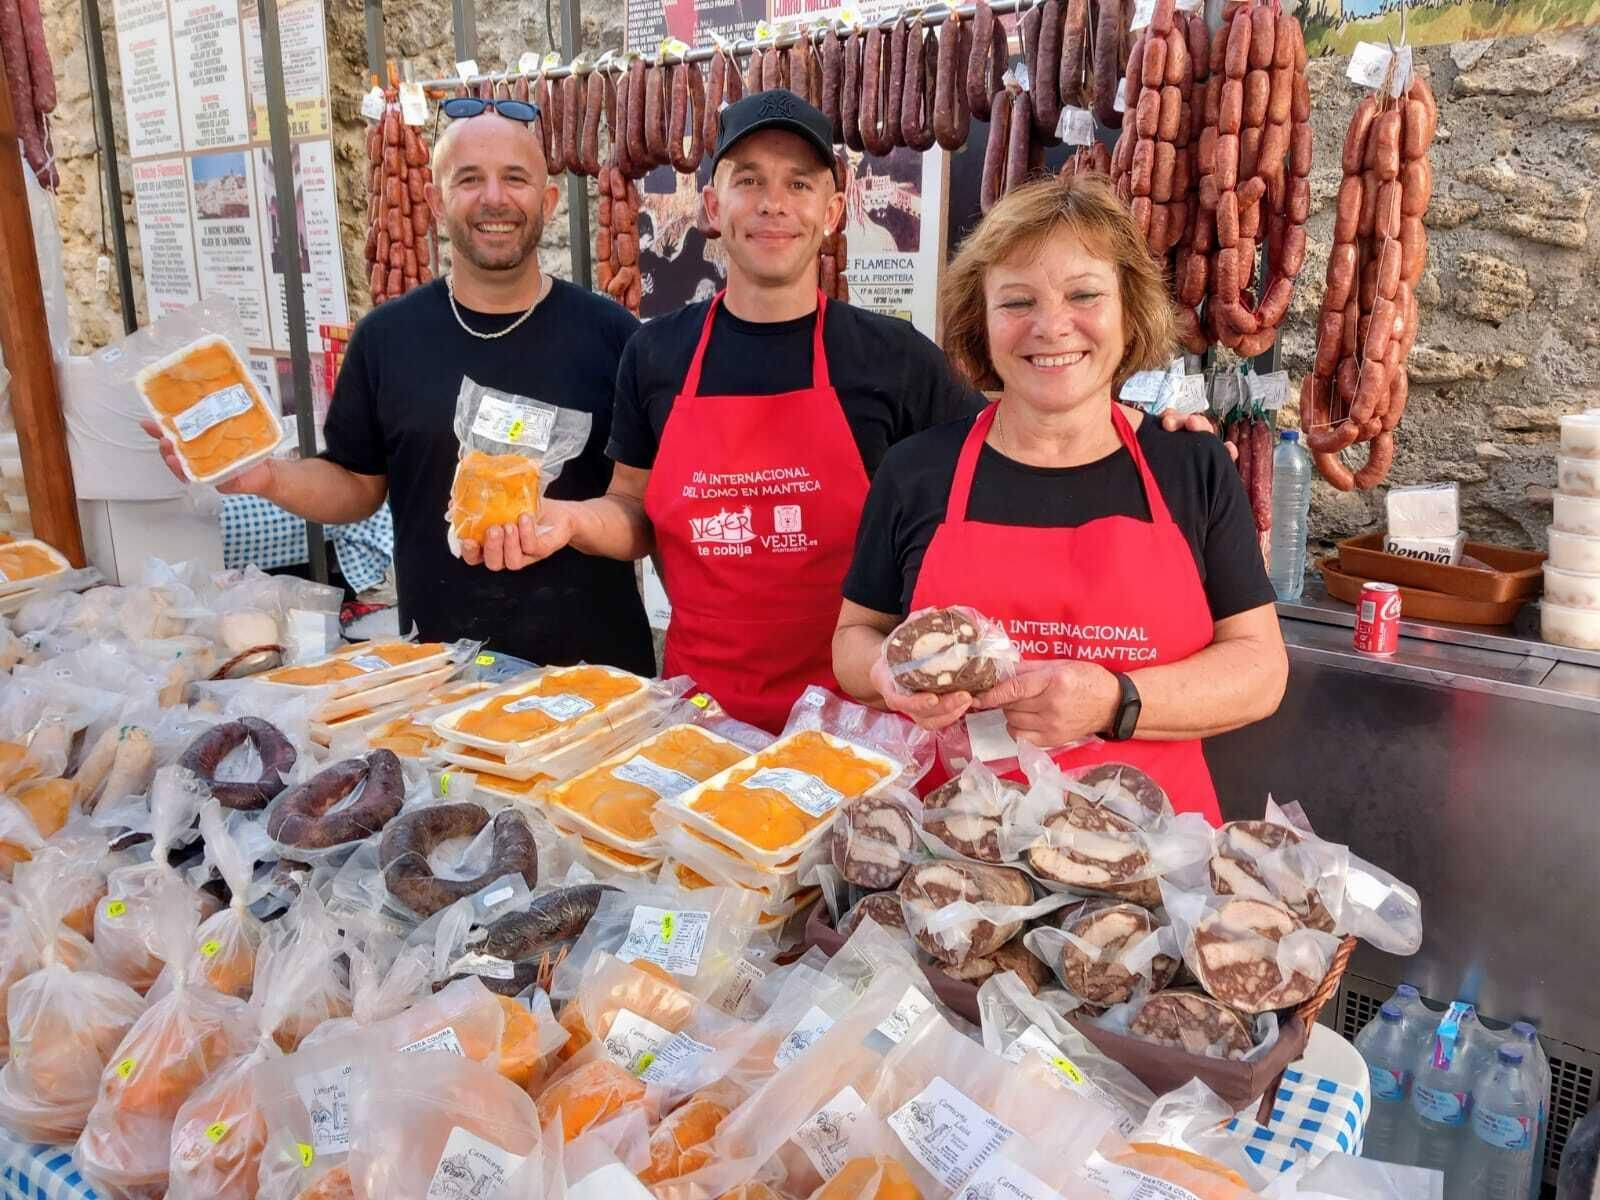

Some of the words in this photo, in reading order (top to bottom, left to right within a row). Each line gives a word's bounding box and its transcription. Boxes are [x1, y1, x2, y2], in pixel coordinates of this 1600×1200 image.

[854, 258, 914, 270] FLAMENCA
[873, 274, 914, 282] FRONTERA
[693, 471, 707, 484] DÍA
[709, 467, 809, 485] INTERNACIONAL
[683, 486, 698, 498] DEL
[701, 488, 738, 499] LOMO
[741, 487, 759, 497] EN
[762, 480, 821, 495] MANTECA
[698, 544, 710, 556] te
[713, 543, 752, 557] cobija
[1386, 542, 1451, 565] Renova
[1010, 619, 1148, 642] INTERNACIONAL
[1009, 639, 1048, 654] OMO
[1053, 641, 1073, 656] EN
[1077, 646, 1157, 661] MANTECA
